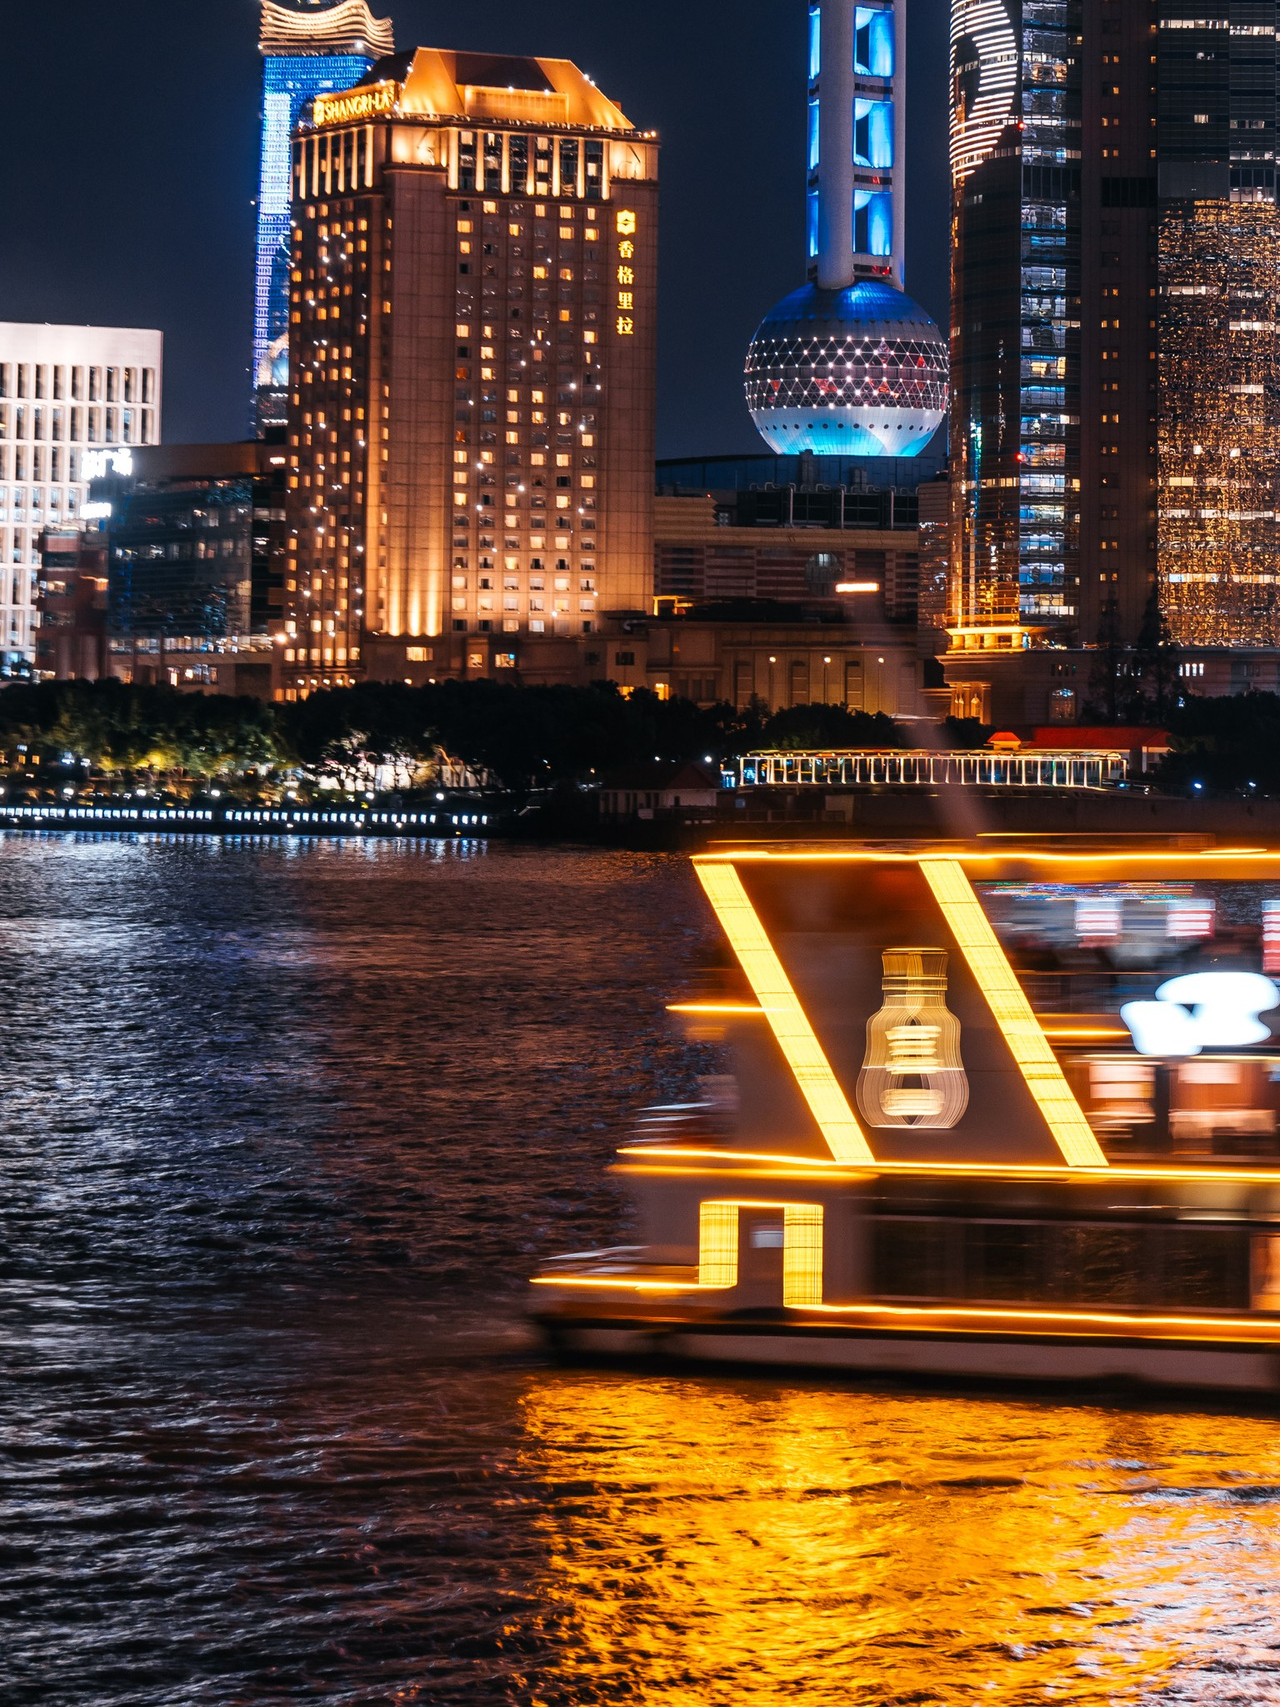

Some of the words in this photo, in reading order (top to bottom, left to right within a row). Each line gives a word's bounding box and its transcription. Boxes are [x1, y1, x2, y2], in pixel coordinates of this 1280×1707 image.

[323, 91, 391, 120] SHANGRI-LA
[616, 240, 635, 335] 香格里拉
